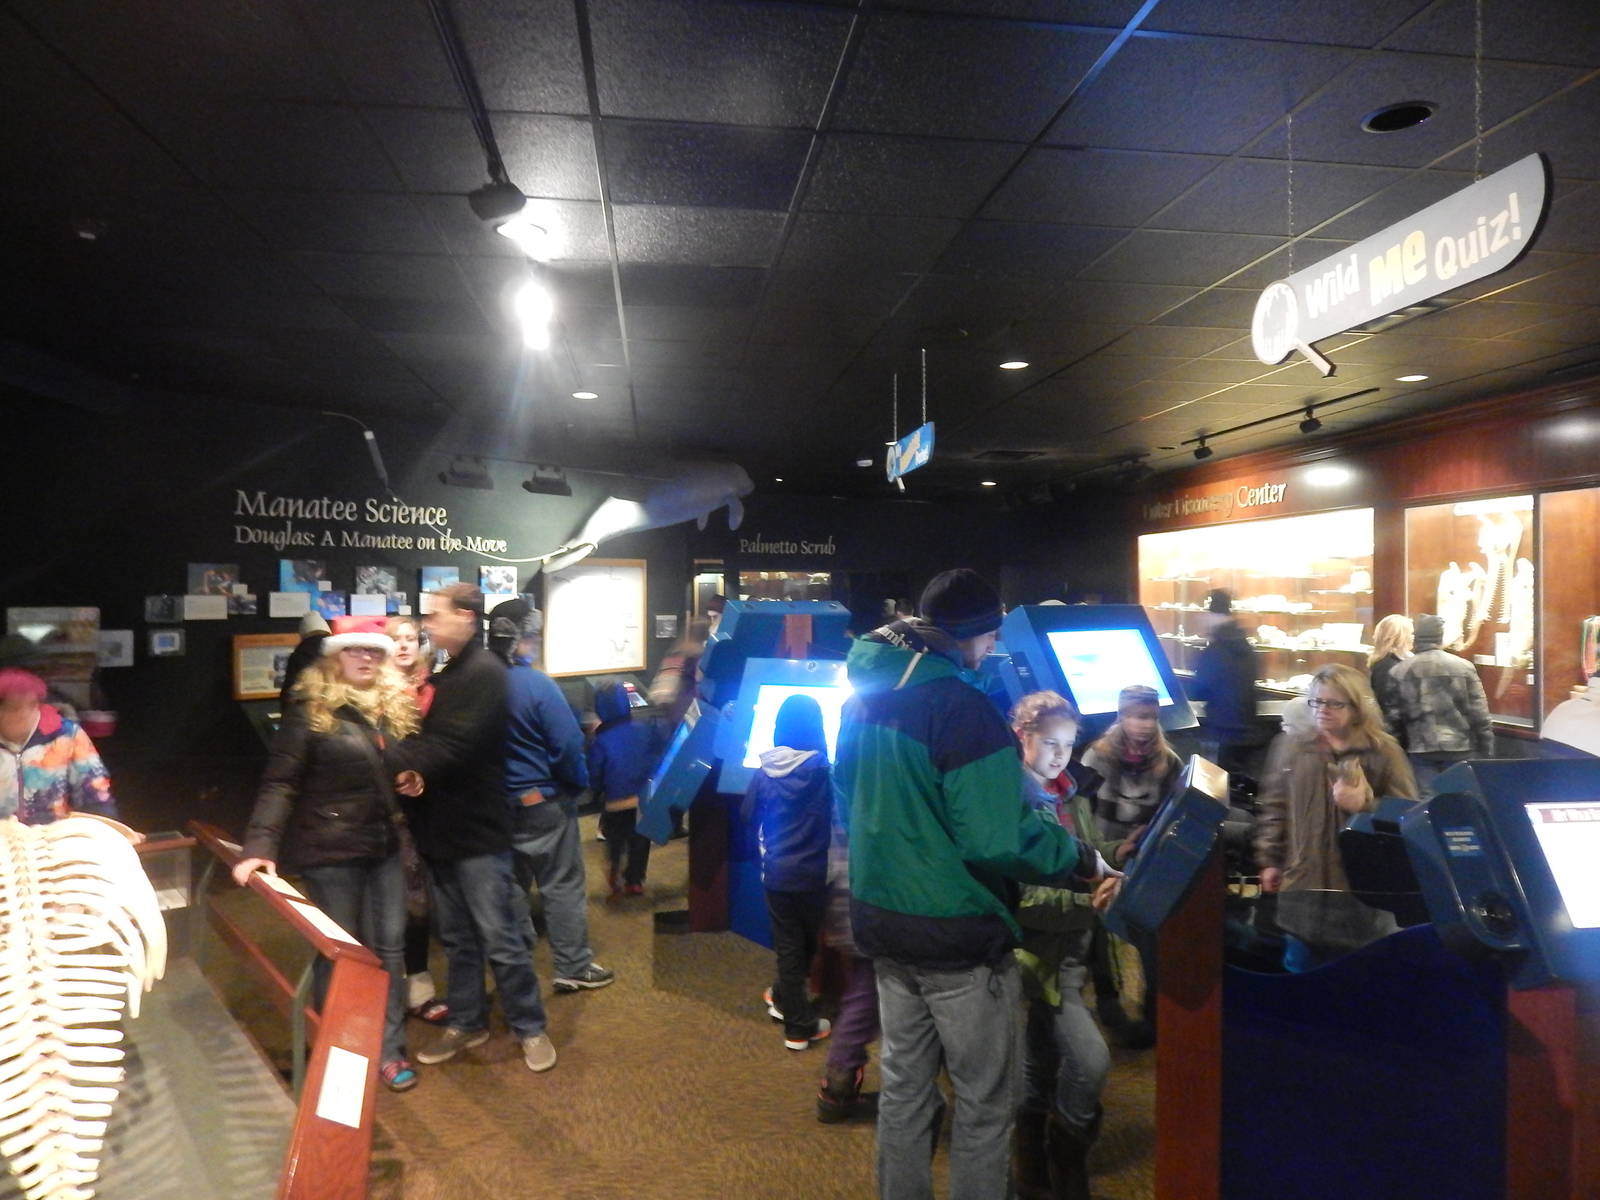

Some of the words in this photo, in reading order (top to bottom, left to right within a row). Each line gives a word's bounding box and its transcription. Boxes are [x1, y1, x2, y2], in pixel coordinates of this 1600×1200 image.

[1305, 253, 1360, 319] Wild
[1434, 191, 1522, 281] Quiz!
[234, 489, 358, 522] Manatee
[365, 498, 448, 527] Science
[1236, 482, 1287, 508] Center
[234, 520, 316, 551] Douglas:
[320, 530, 336, 547] A
[340, 530, 413, 550] Manatee
[416, 535, 436, 551] on
[440, 528, 463, 553] the
[465, 535, 508, 553] Move
[740, 532, 798, 554] Palmetto
[800, 535, 836, 555] Scrub
